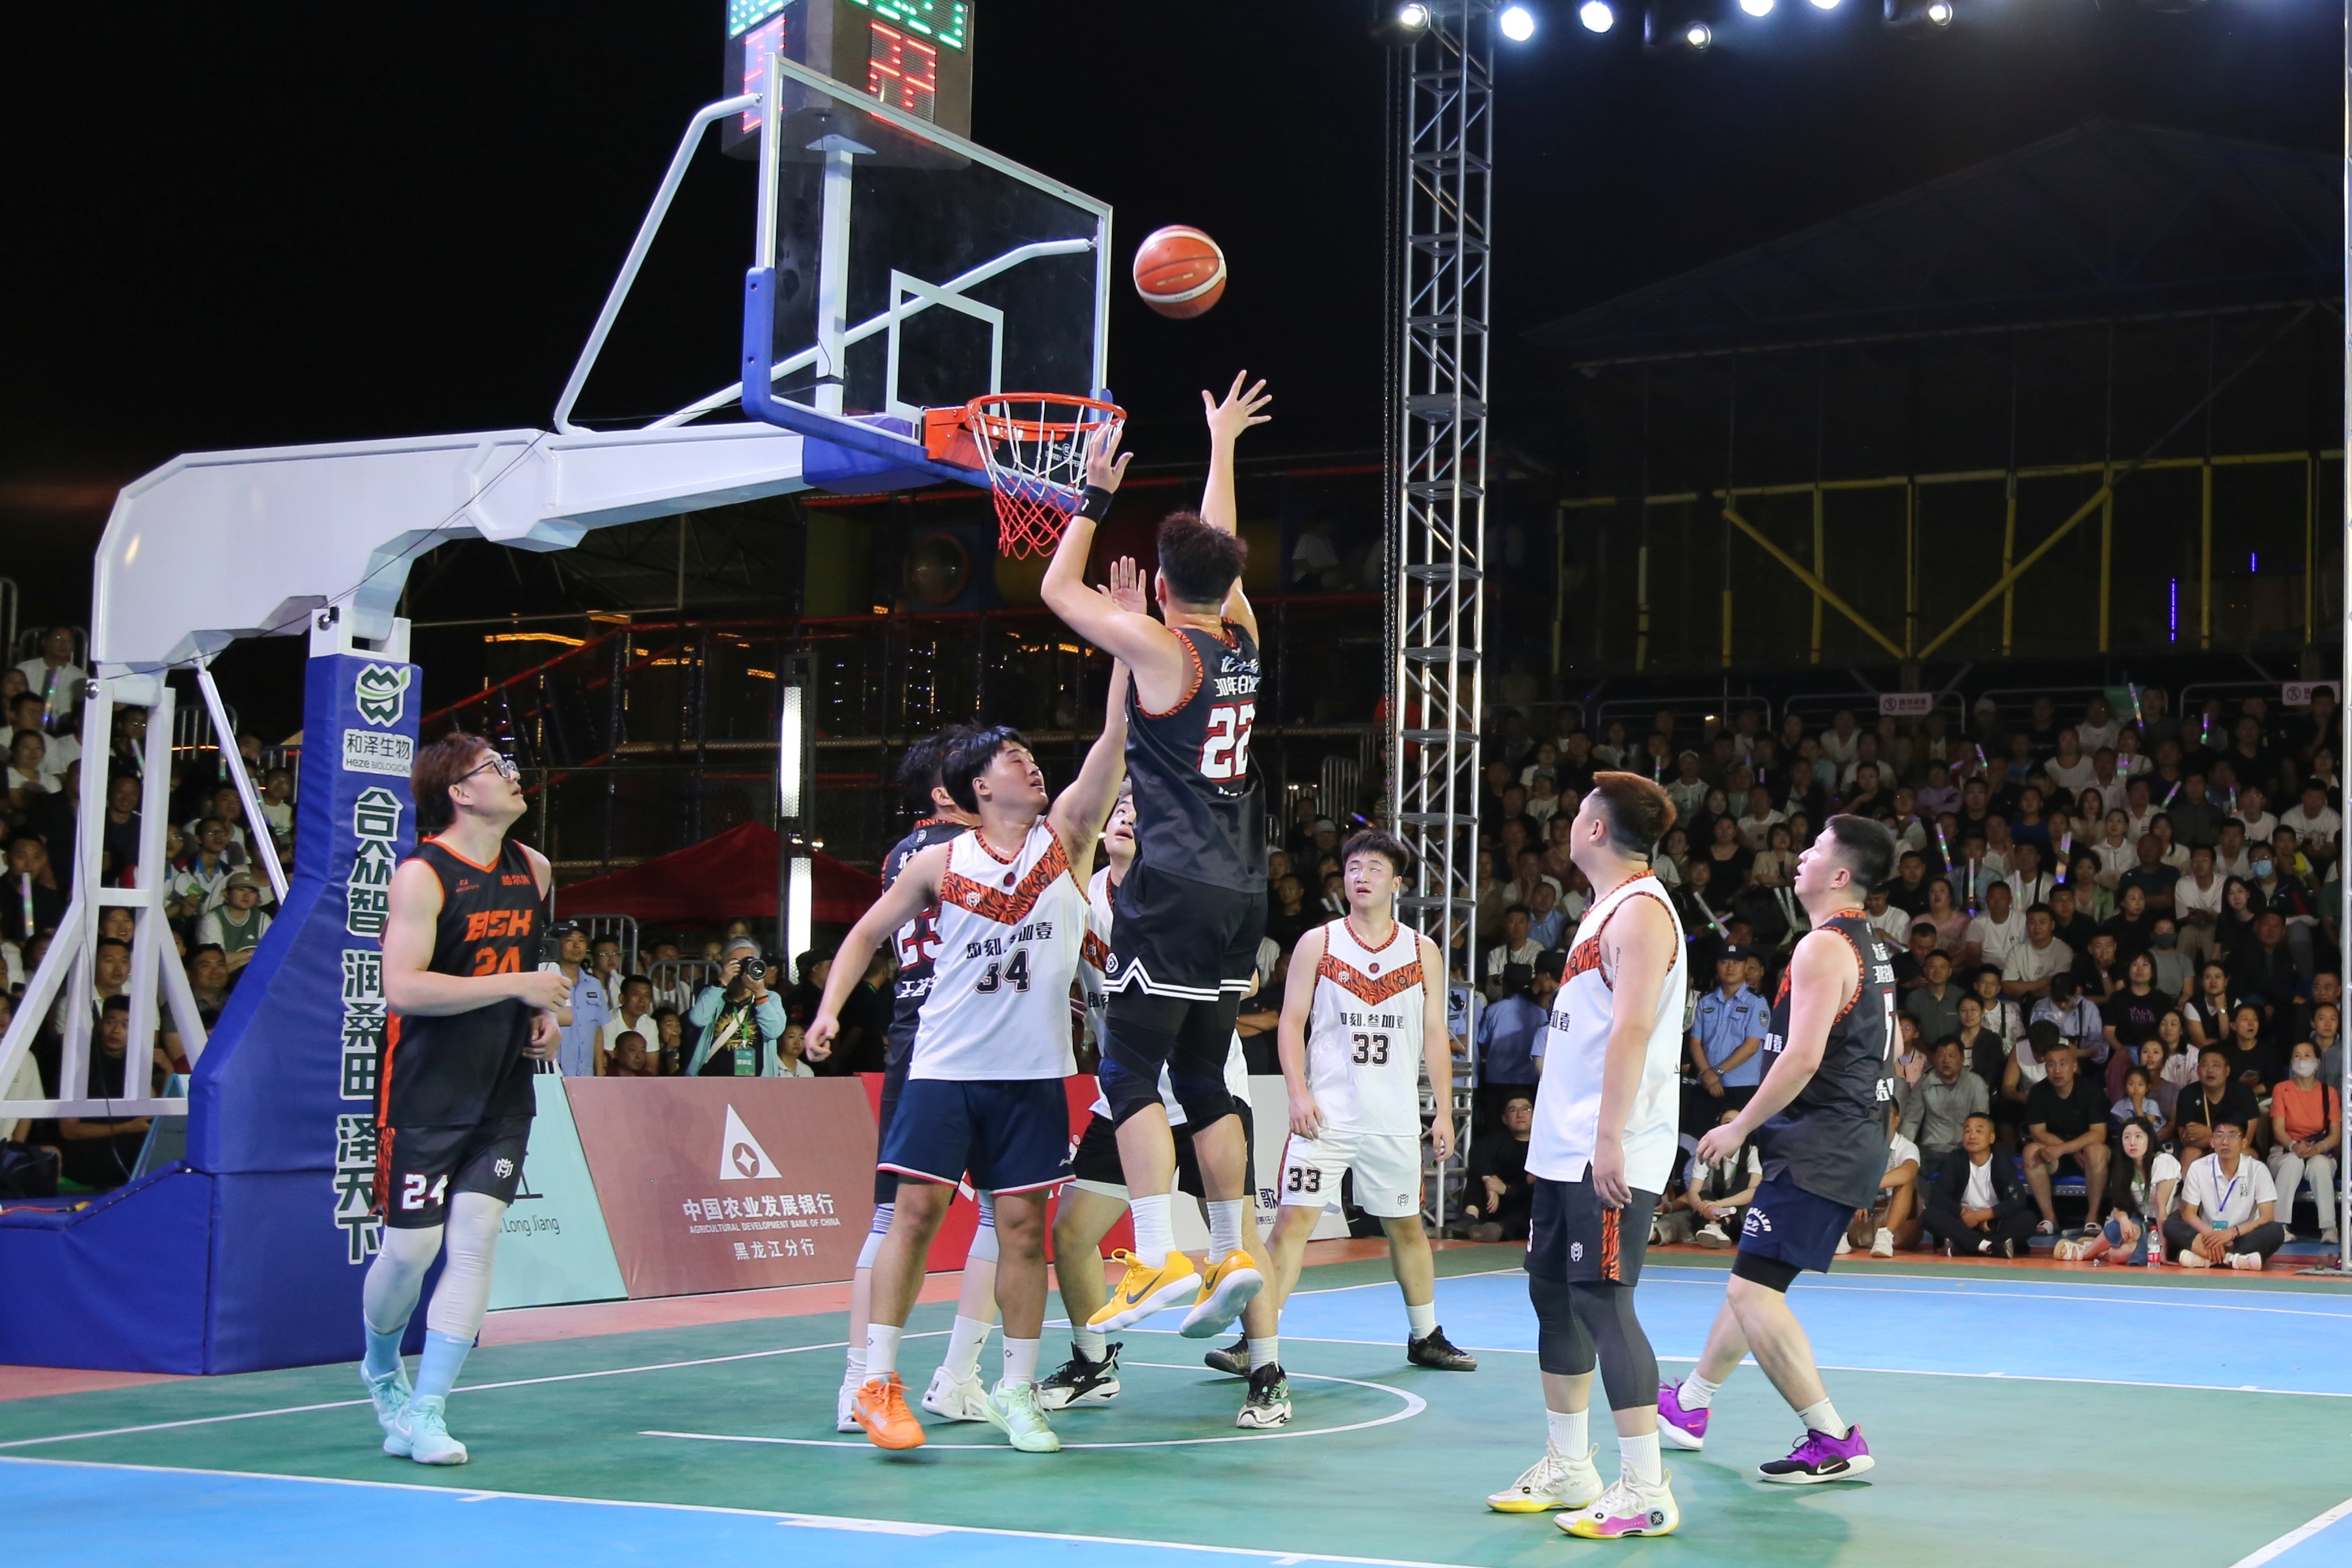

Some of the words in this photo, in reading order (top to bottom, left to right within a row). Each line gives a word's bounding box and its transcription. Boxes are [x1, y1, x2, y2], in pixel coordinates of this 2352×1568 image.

[347, 733, 411, 760] 和泽生物
[1198, 701, 1256, 781] 22
[349, 789, 398, 934] 合众智
[342, 951, 386, 1098] 润桑田
[1351, 1032, 1391, 1066] 33
[336, 1116, 382, 1262] 泽天下
[402, 1173, 449, 1210] 24
[1287, 1166, 1322, 1194] 33
[683, 1193, 835, 1222] 中国农业发展银行
[503, 1217, 532, 1236] Long
[532, 1215, 560, 1234] Jiang
[689, 1223, 741, 1234] AGRICULTURAL
[742, 1219, 790, 1231] DEVELOPMENT
[791, 1219, 809, 1228] BANK
[810, 1218, 818, 1227] OF
[820, 1217, 841, 1227] CHINA
[733, 1238, 816, 1260] 黑龙江分行
